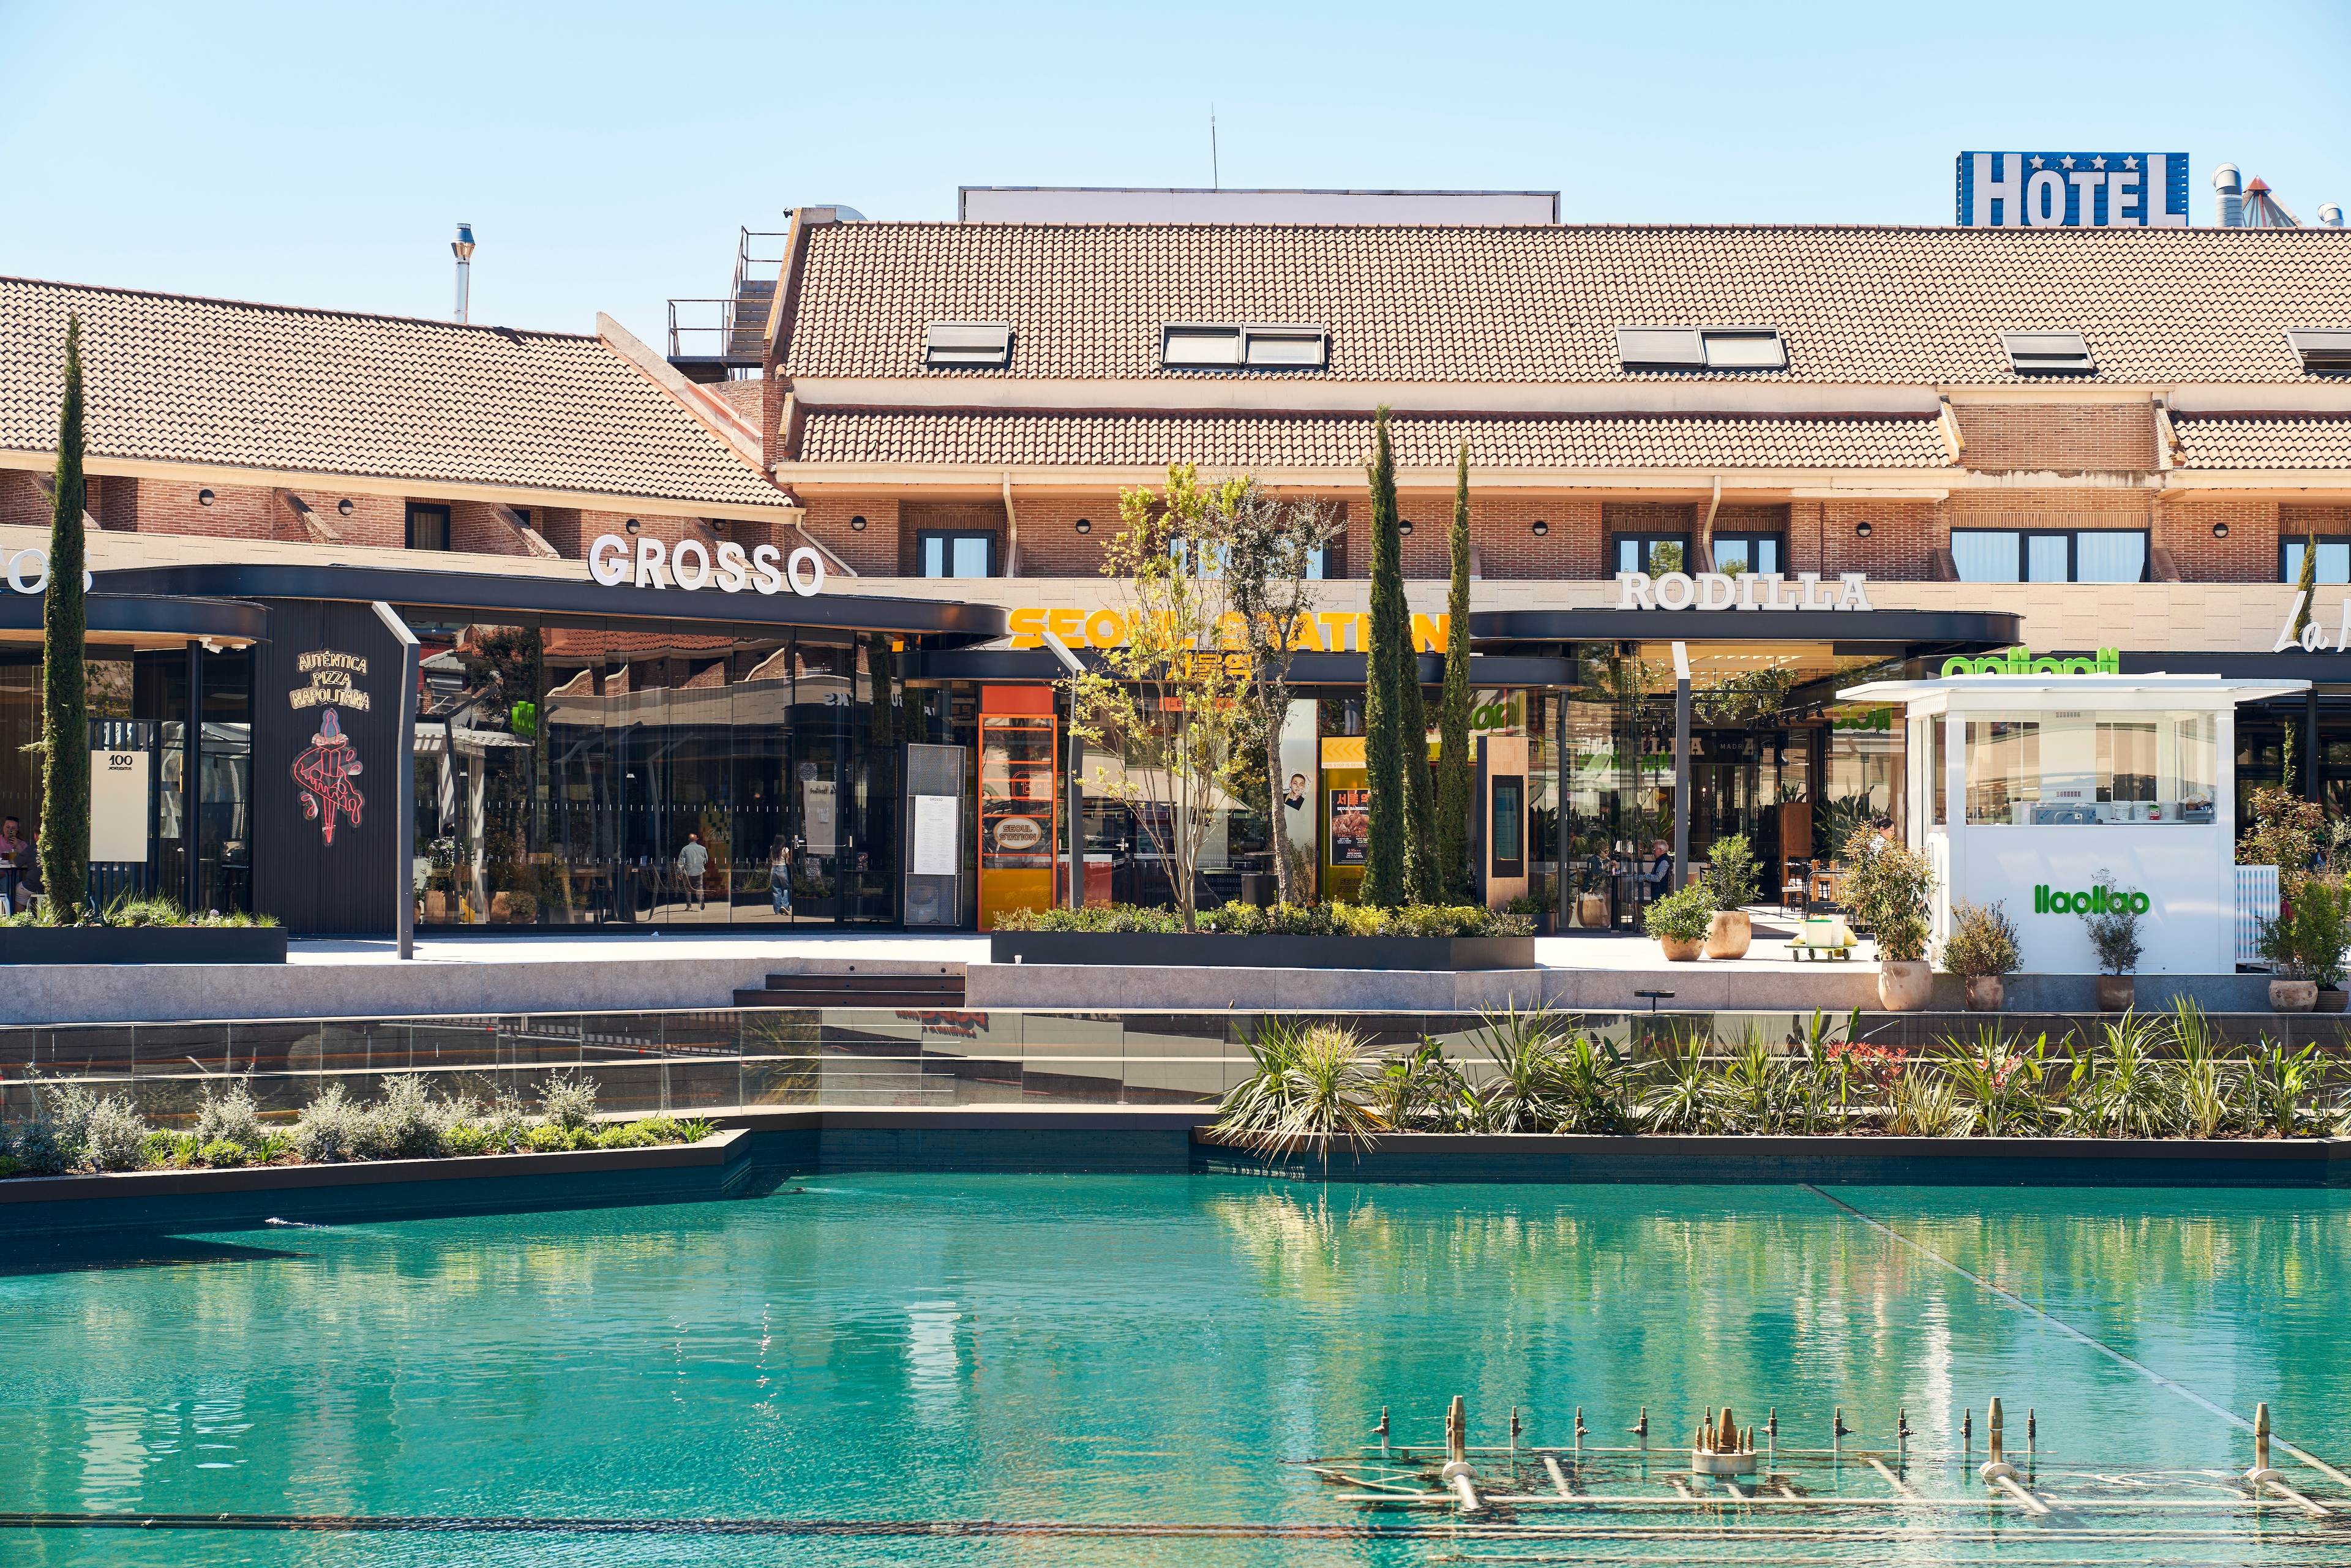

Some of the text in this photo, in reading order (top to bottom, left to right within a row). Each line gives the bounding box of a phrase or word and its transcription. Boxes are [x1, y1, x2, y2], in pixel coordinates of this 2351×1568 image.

[1973, 153, 2186, 227] HOTEL
[588, 534, 825, 597] GROSSO
[1615, 572, 1873, 612] RODILLA
[1008, 607, 1450, 653] SEOUL STATIN
[2272, 591, 2330, 653] La
[299, 651, 367, 673] AUTÉNTICA
[312, 671, 350, 687] PIZZA
[292, 689, 370, 710] NAPOLITANA
[109, 754, 133, 765] 100
[2034, 885, 2150, 914] llaollao
